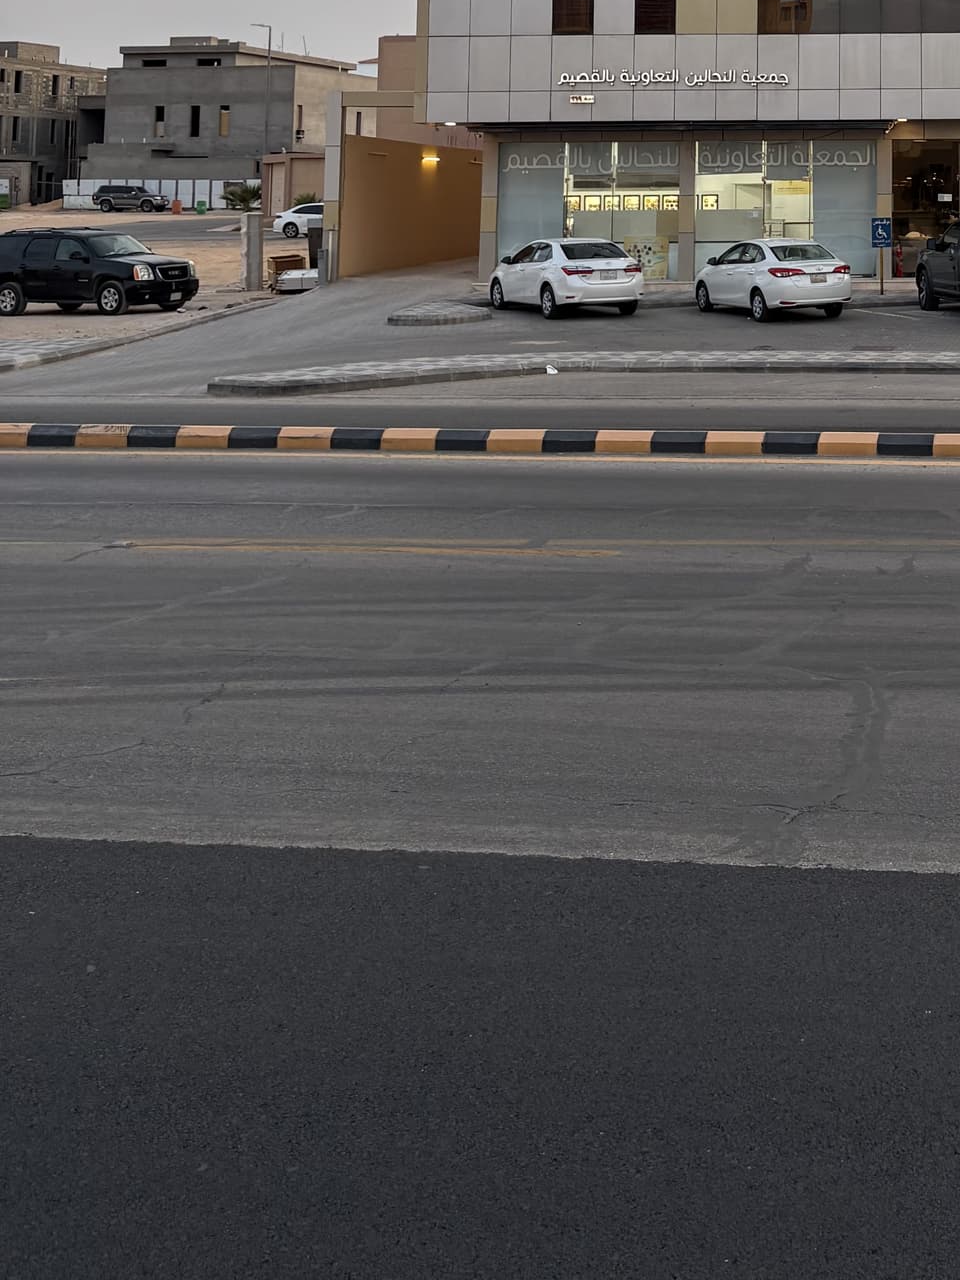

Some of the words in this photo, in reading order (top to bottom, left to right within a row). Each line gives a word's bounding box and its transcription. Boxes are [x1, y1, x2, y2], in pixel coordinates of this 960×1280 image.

[557, 68, 615, 86] بالقصيم
[620, 69, 680, 87] التعاونية
[684, 69, 737, 87] النحالين
[741, 69, 790, 87] جمعية
[598, 144, 680, 174] للنحالين
[700, 143, 788, 173] التعاونية
[791, 143, 876, 172] الجمعة
